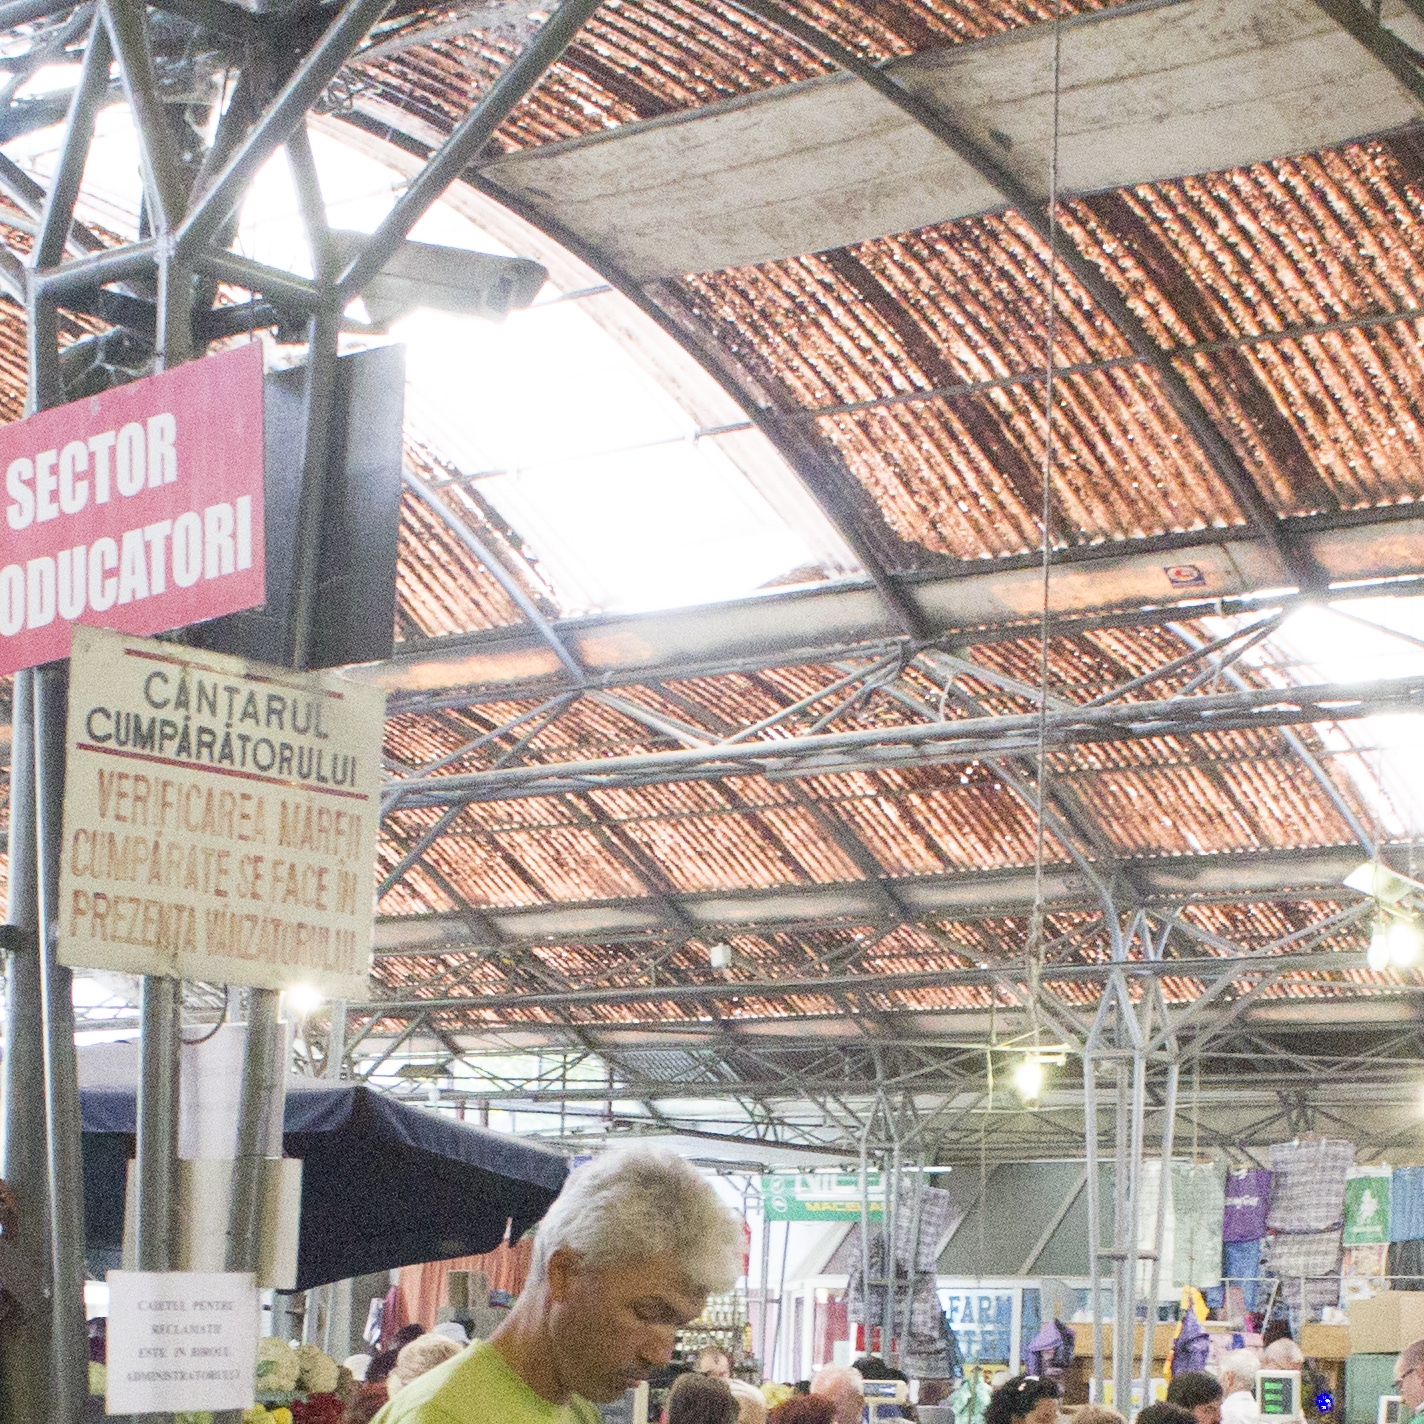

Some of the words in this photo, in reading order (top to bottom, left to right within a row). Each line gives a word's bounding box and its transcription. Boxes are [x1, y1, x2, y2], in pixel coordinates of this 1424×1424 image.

[5, 411, 178, 532] SECTOR
[97, 767, 268, 844] VERIFICAREA
[235, 853, 264, 901] SE
[269, 859, 329, 911] FACE
